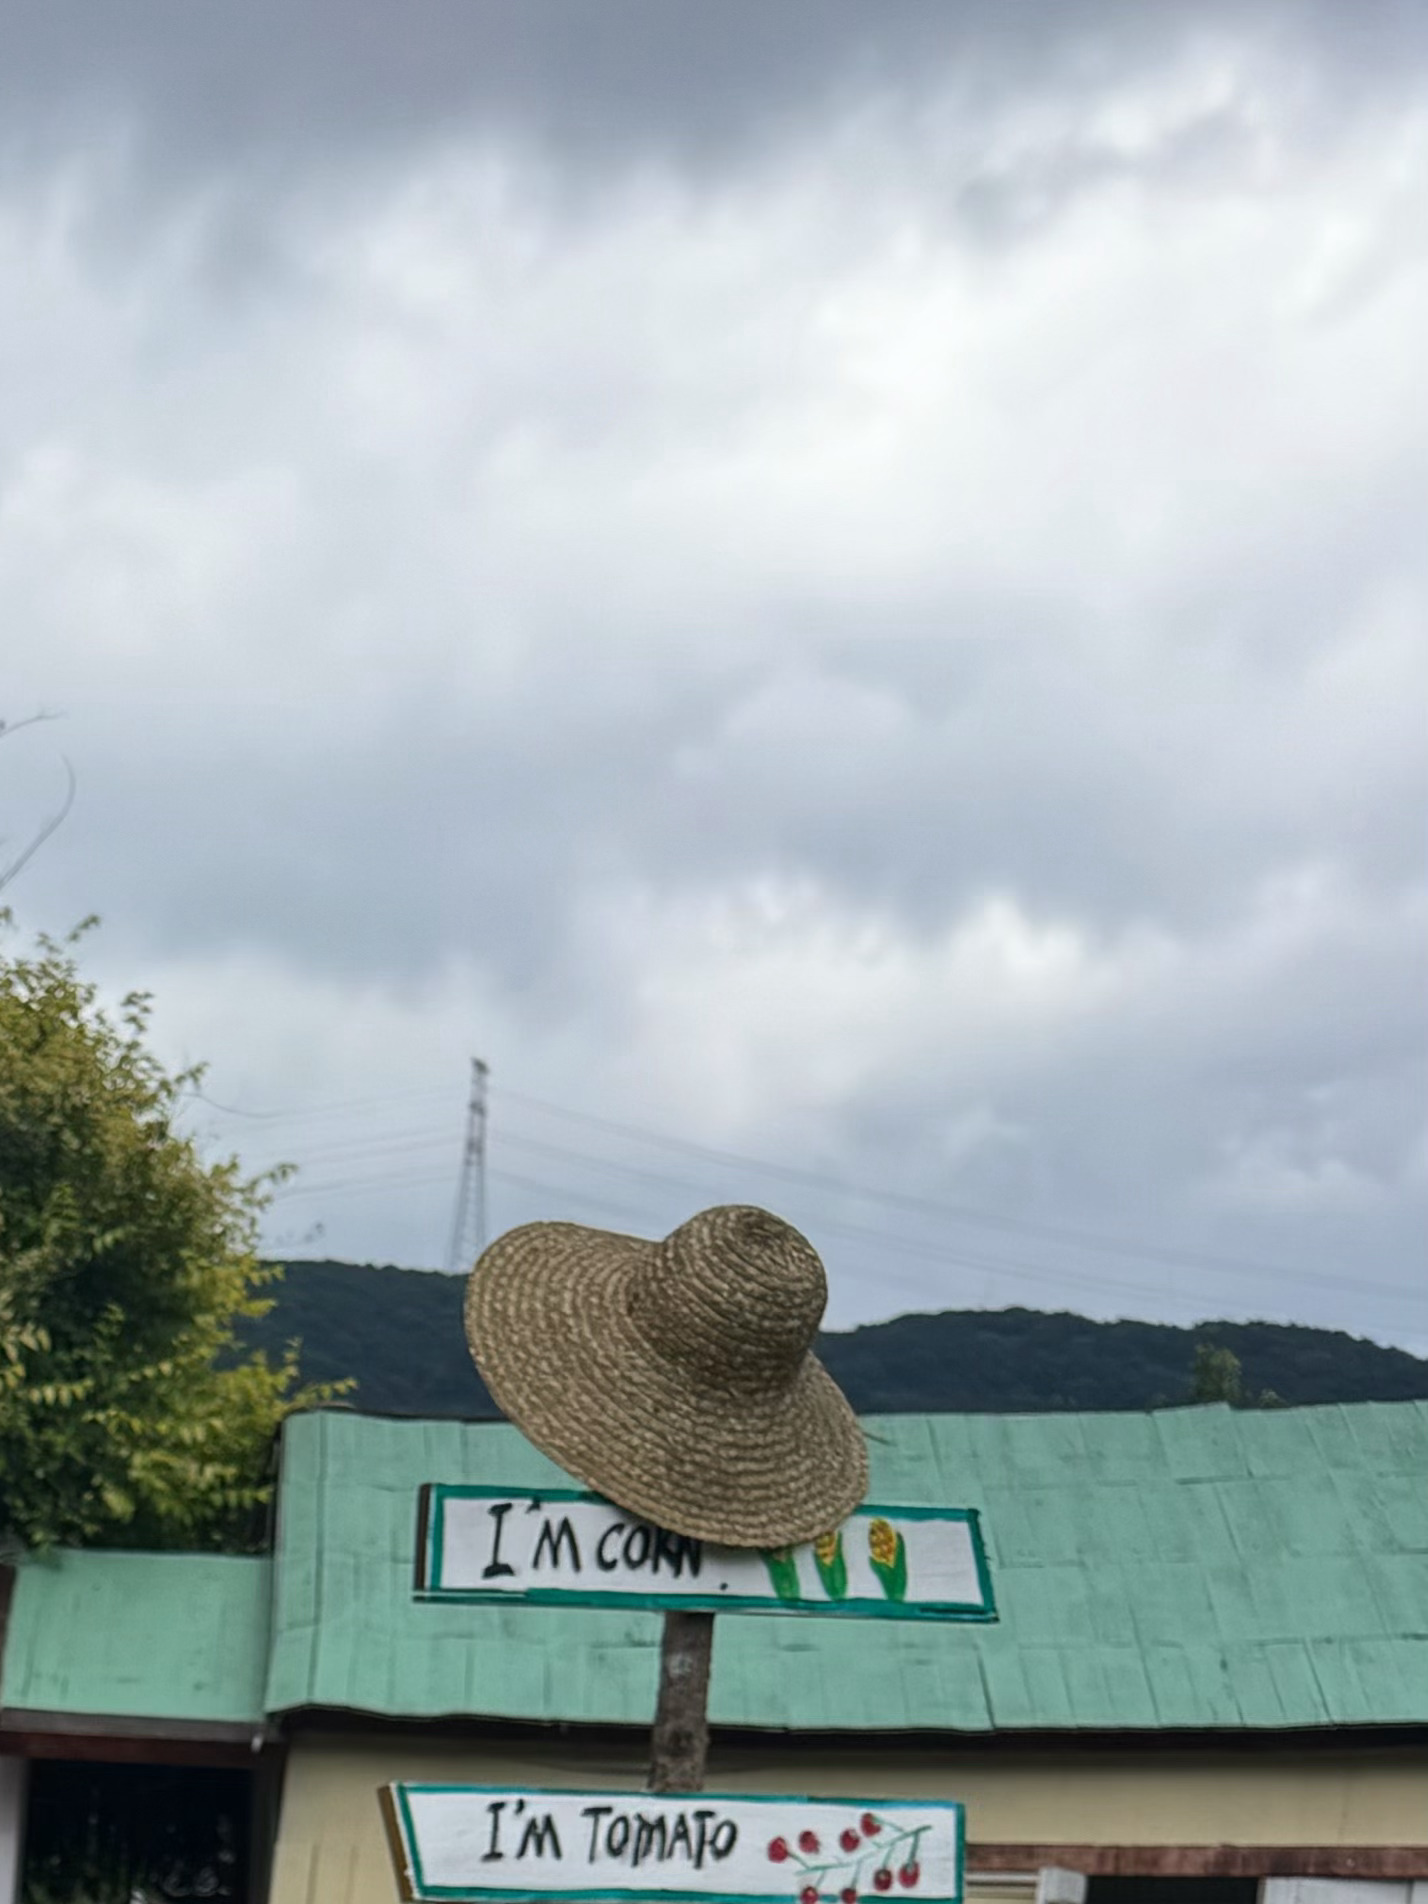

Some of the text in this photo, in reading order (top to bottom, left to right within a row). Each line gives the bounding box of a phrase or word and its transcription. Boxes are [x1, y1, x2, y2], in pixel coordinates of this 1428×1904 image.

[482, 1497, 582, 1580] I'M
[481, 1799, 739, 1870] I'M TOMATO
